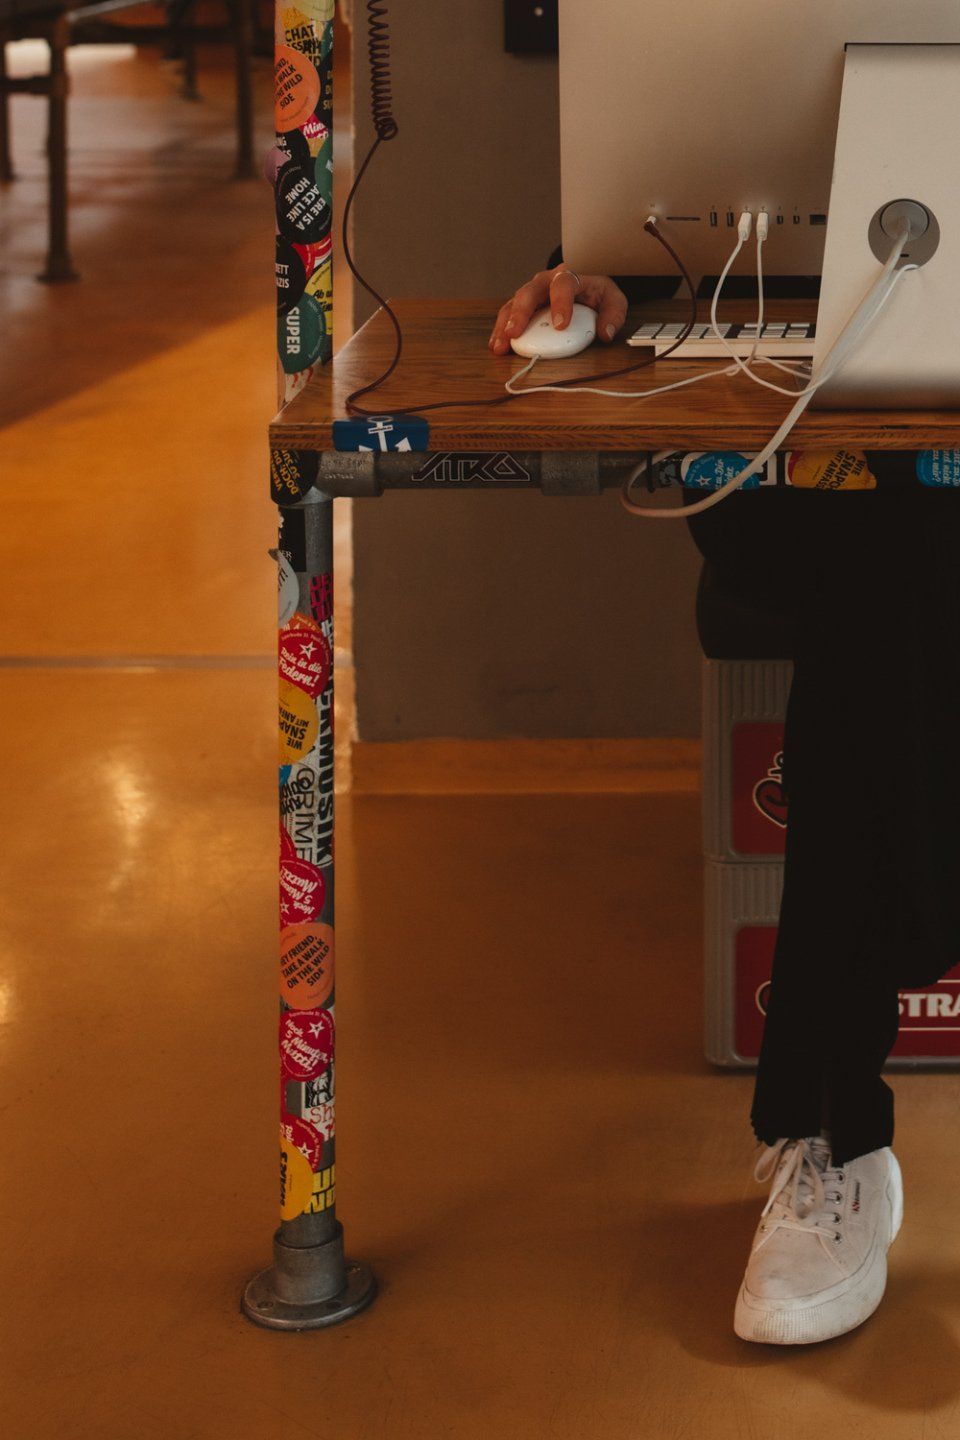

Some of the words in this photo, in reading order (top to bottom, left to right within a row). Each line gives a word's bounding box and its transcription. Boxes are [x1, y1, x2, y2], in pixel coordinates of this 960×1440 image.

[283, 74, 303, 93] WILD
[279, 94, 295, 110] SIDE
[285, 176, 311, 204] HOME
[285, 203, 306, 223] LIKE
[280, 646, 298, 663] Rein
[308, 662, 323, 675] die
[279, 659, 321, 688] Federn!
[279, 720, 308, 741] SNAP
[286, 738, 303, 750] WIE
[288, 934, 318, 959] FRIEND,
[282, 962, 299, 979] TAKE
[304, 939, 325, 962] WALK
[286, 975, 299, 990] ON
[298, 964, 313, 981] THE
[311, 944, 331, 966] WILD
[306, 968, 325, 987] SIDE
